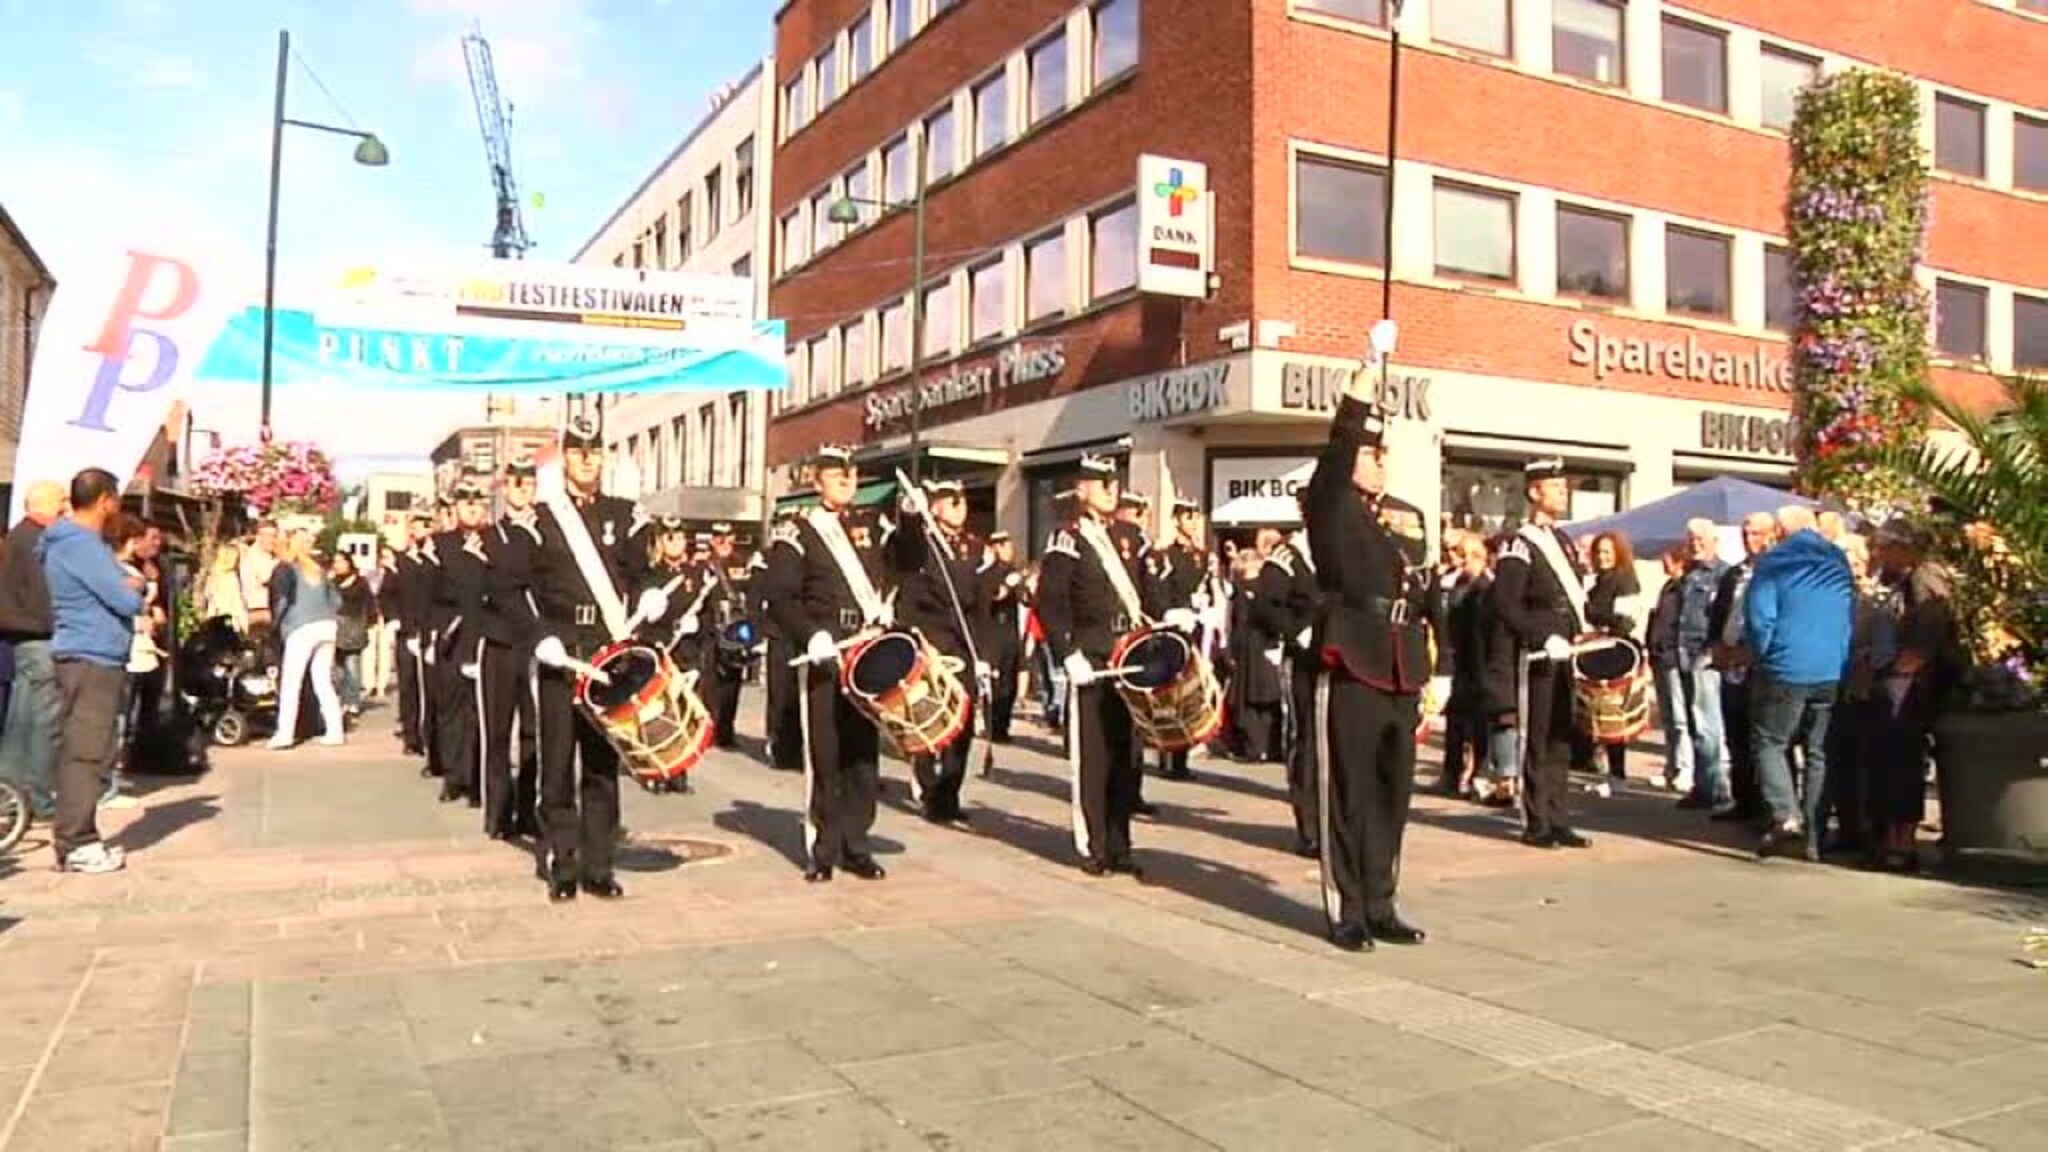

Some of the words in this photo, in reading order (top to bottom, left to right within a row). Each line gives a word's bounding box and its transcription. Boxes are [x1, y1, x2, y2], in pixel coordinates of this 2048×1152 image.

[457, 282, 685, 315] TESTFESTIVALEN
[1569, 317, 1795, 393] Sparebanke
[1271, 479, 1298, 498] BO
